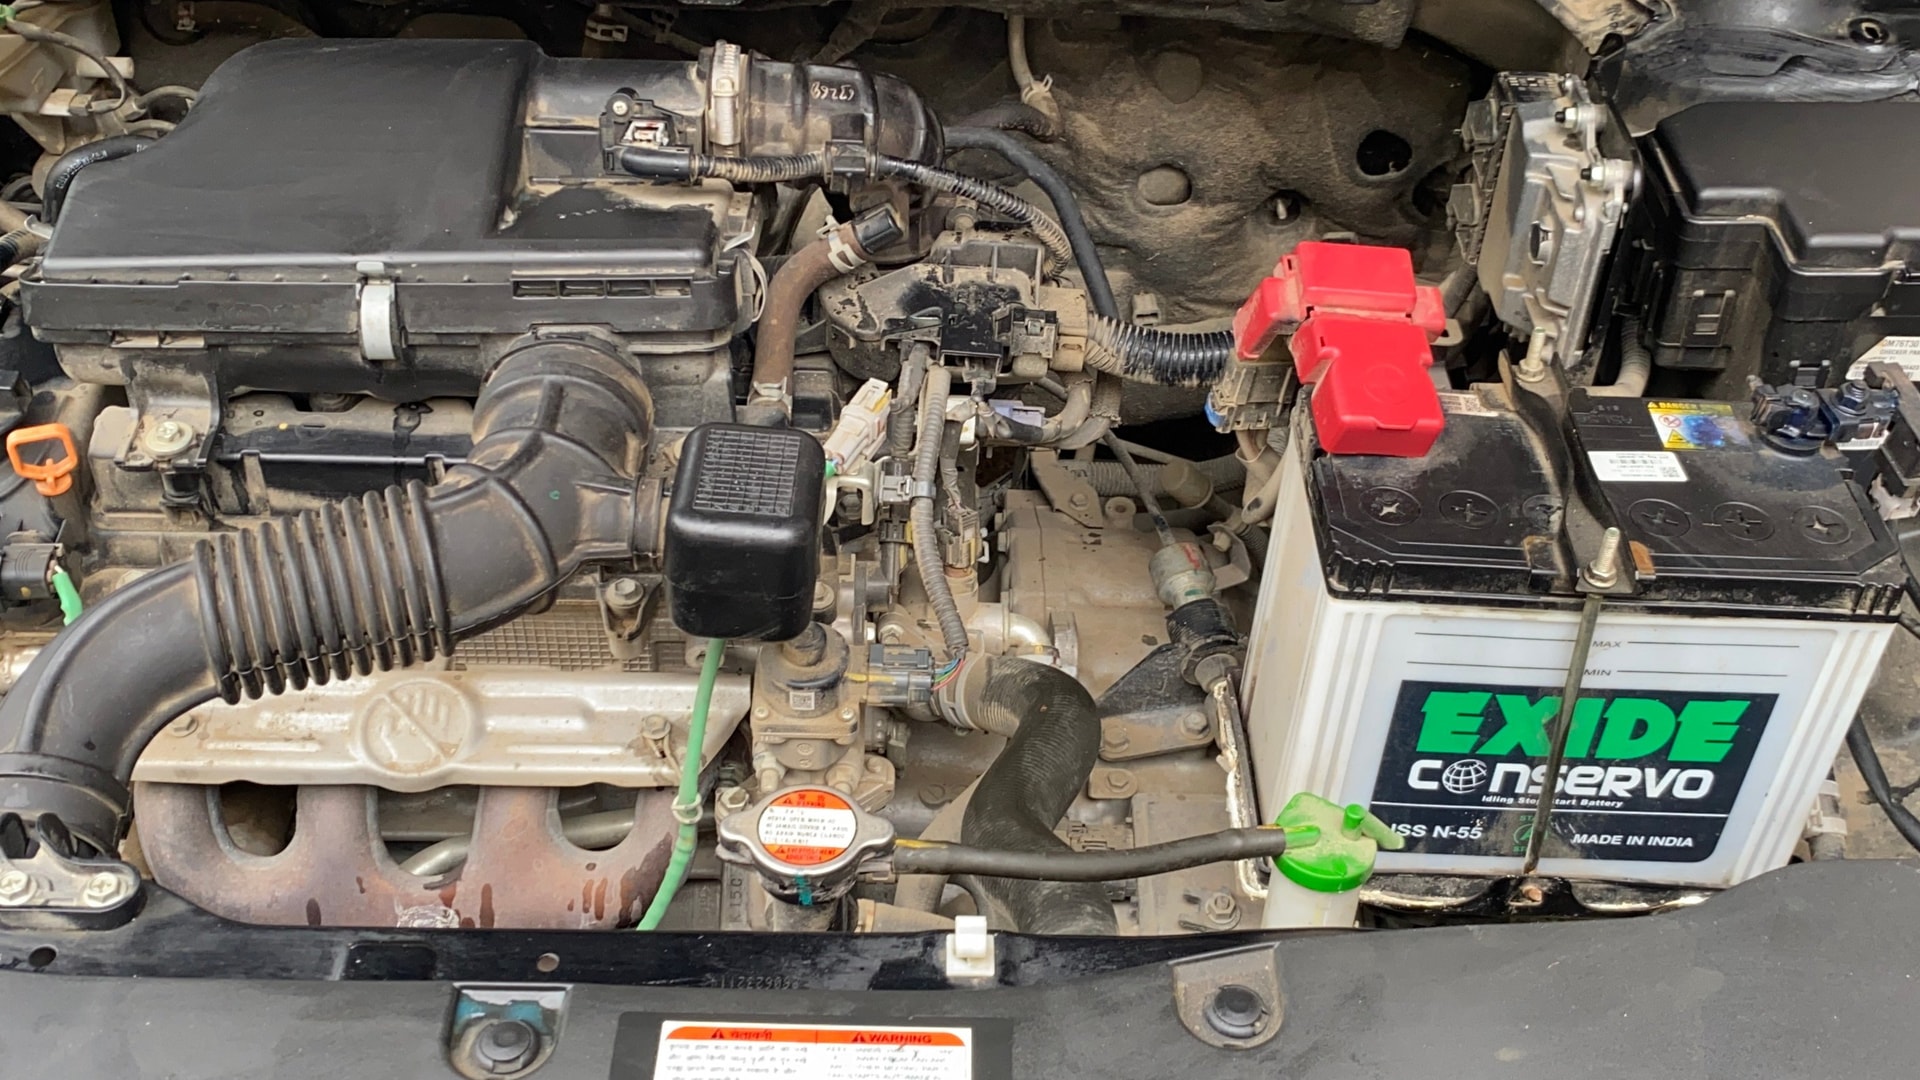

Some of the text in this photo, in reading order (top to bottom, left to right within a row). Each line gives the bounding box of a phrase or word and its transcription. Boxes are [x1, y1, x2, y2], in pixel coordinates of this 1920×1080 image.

[1592, 640, 1621, 648] MAX
[1416, 691, 1751, 764] EXIDE
[1481, 795, 1514, 805] Idling
[1579, 798, 1624, 809] Battery
[1432, 825, 1484, 840] N-55
[1572, 833, 1694, 848] MADE IN INDIA
[868, 1033, 933, 1044] WARNING
